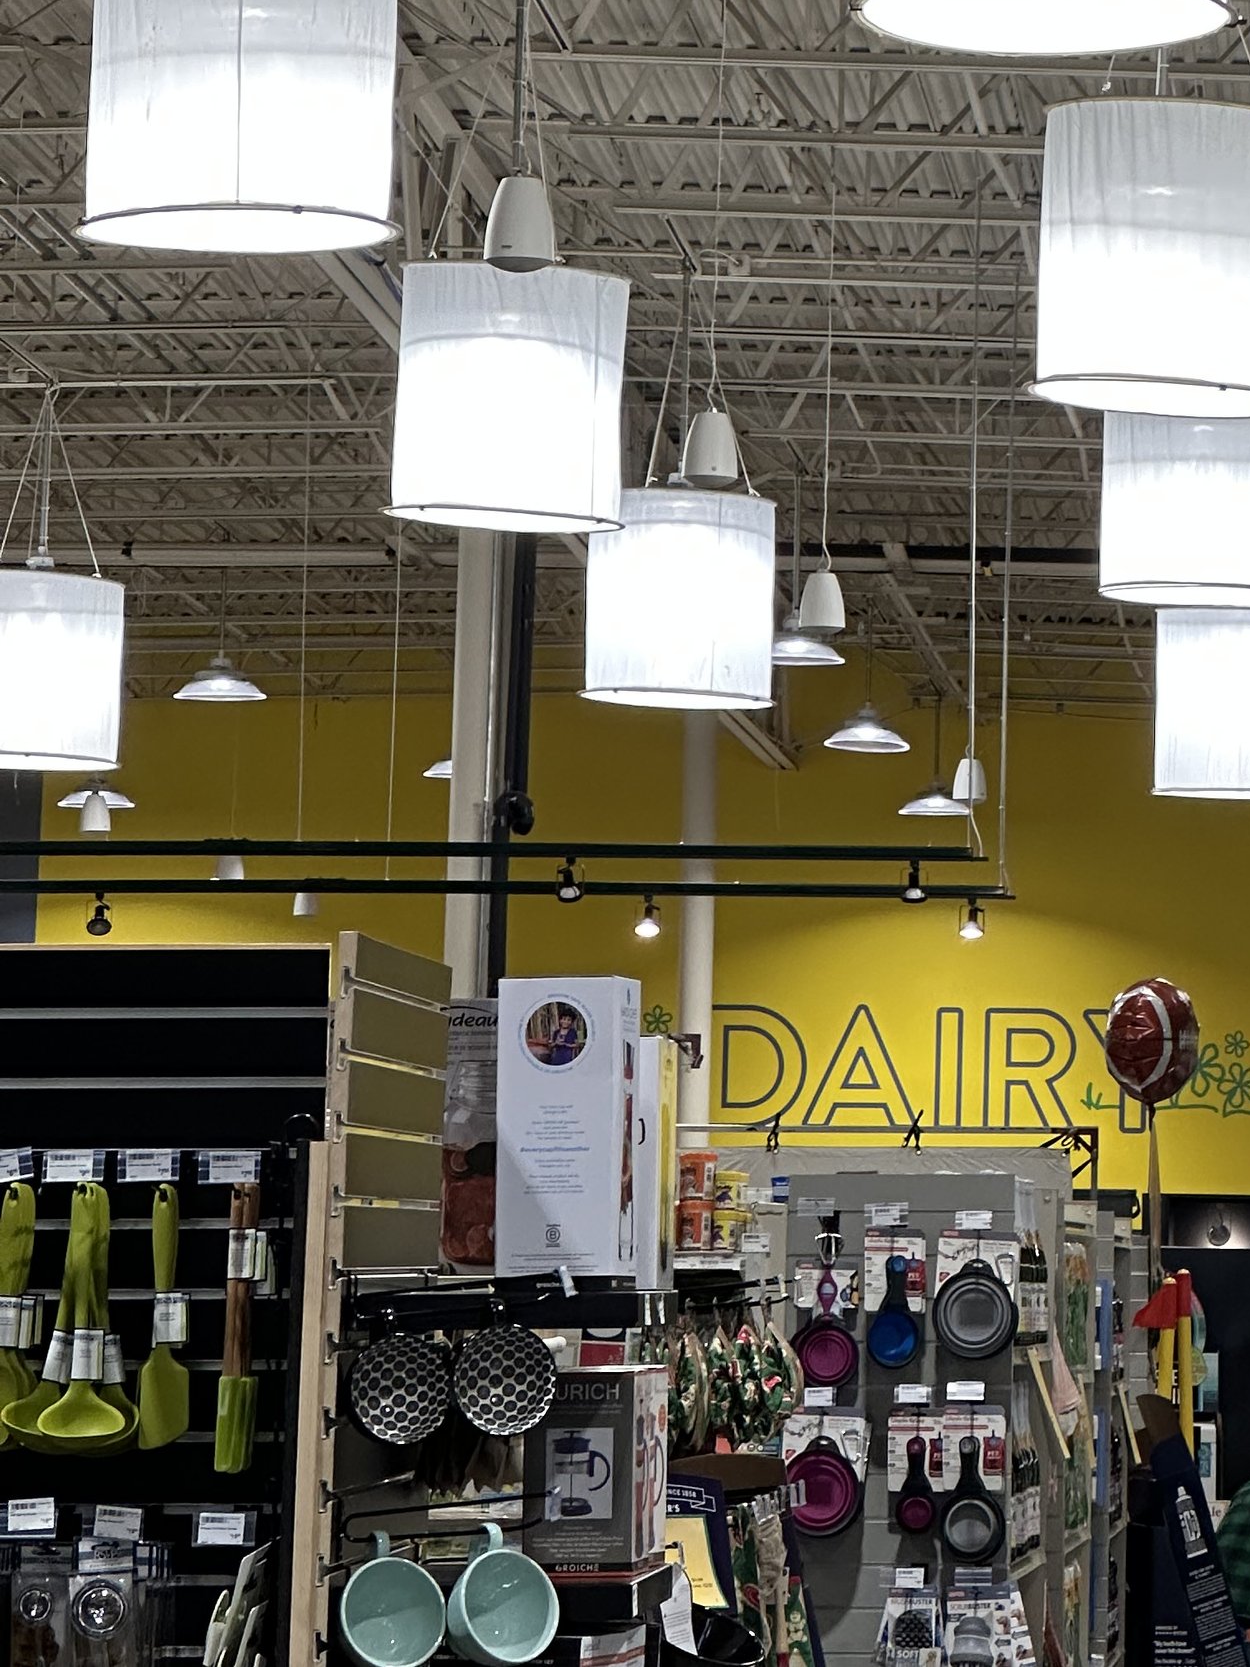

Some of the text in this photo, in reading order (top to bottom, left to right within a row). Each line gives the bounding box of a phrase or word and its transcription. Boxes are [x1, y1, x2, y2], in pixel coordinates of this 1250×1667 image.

[556, 1383, 620, 1401] URICH
[667, 1488, 681, 1496] NCE
[667, 1503, 680, 1513] R'S
